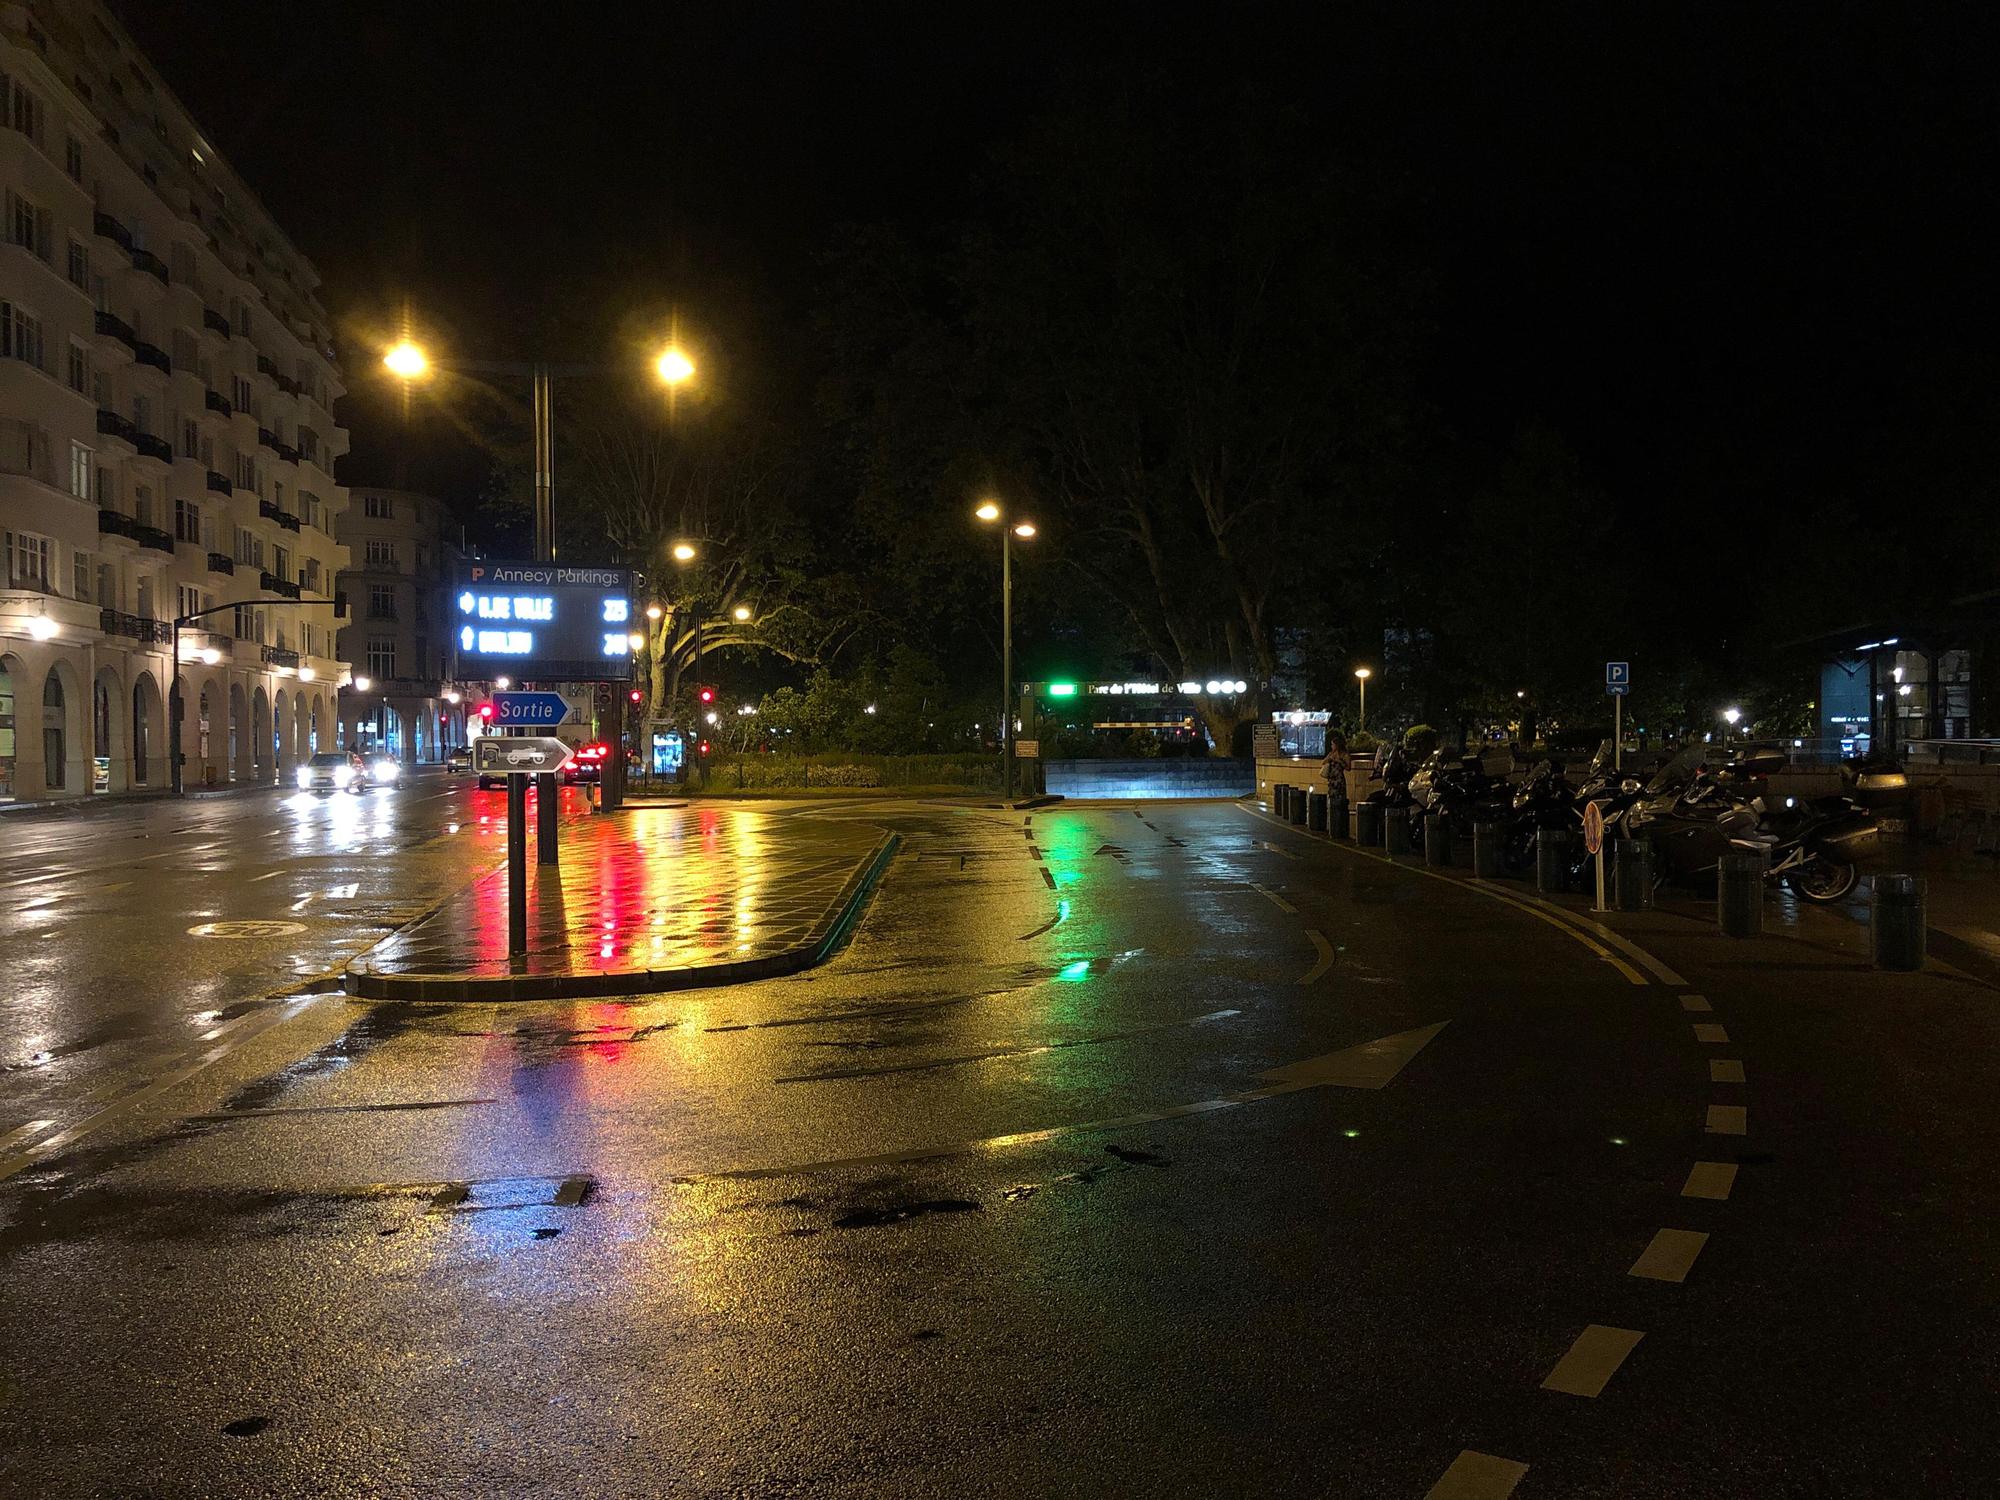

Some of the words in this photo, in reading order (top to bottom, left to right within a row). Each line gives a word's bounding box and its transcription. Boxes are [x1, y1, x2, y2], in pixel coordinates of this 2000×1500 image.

[472, 568, 485, 582] P
[493, 567, 553, 585] Annecy
[557, 568, 620, 587] Parkings
[1612, 666, 1623, 680] P
[1088, 683, 1108, 694] Parc
[1161, 683, 1174, 694] de
[500, 700, 553, 718] Sortie
